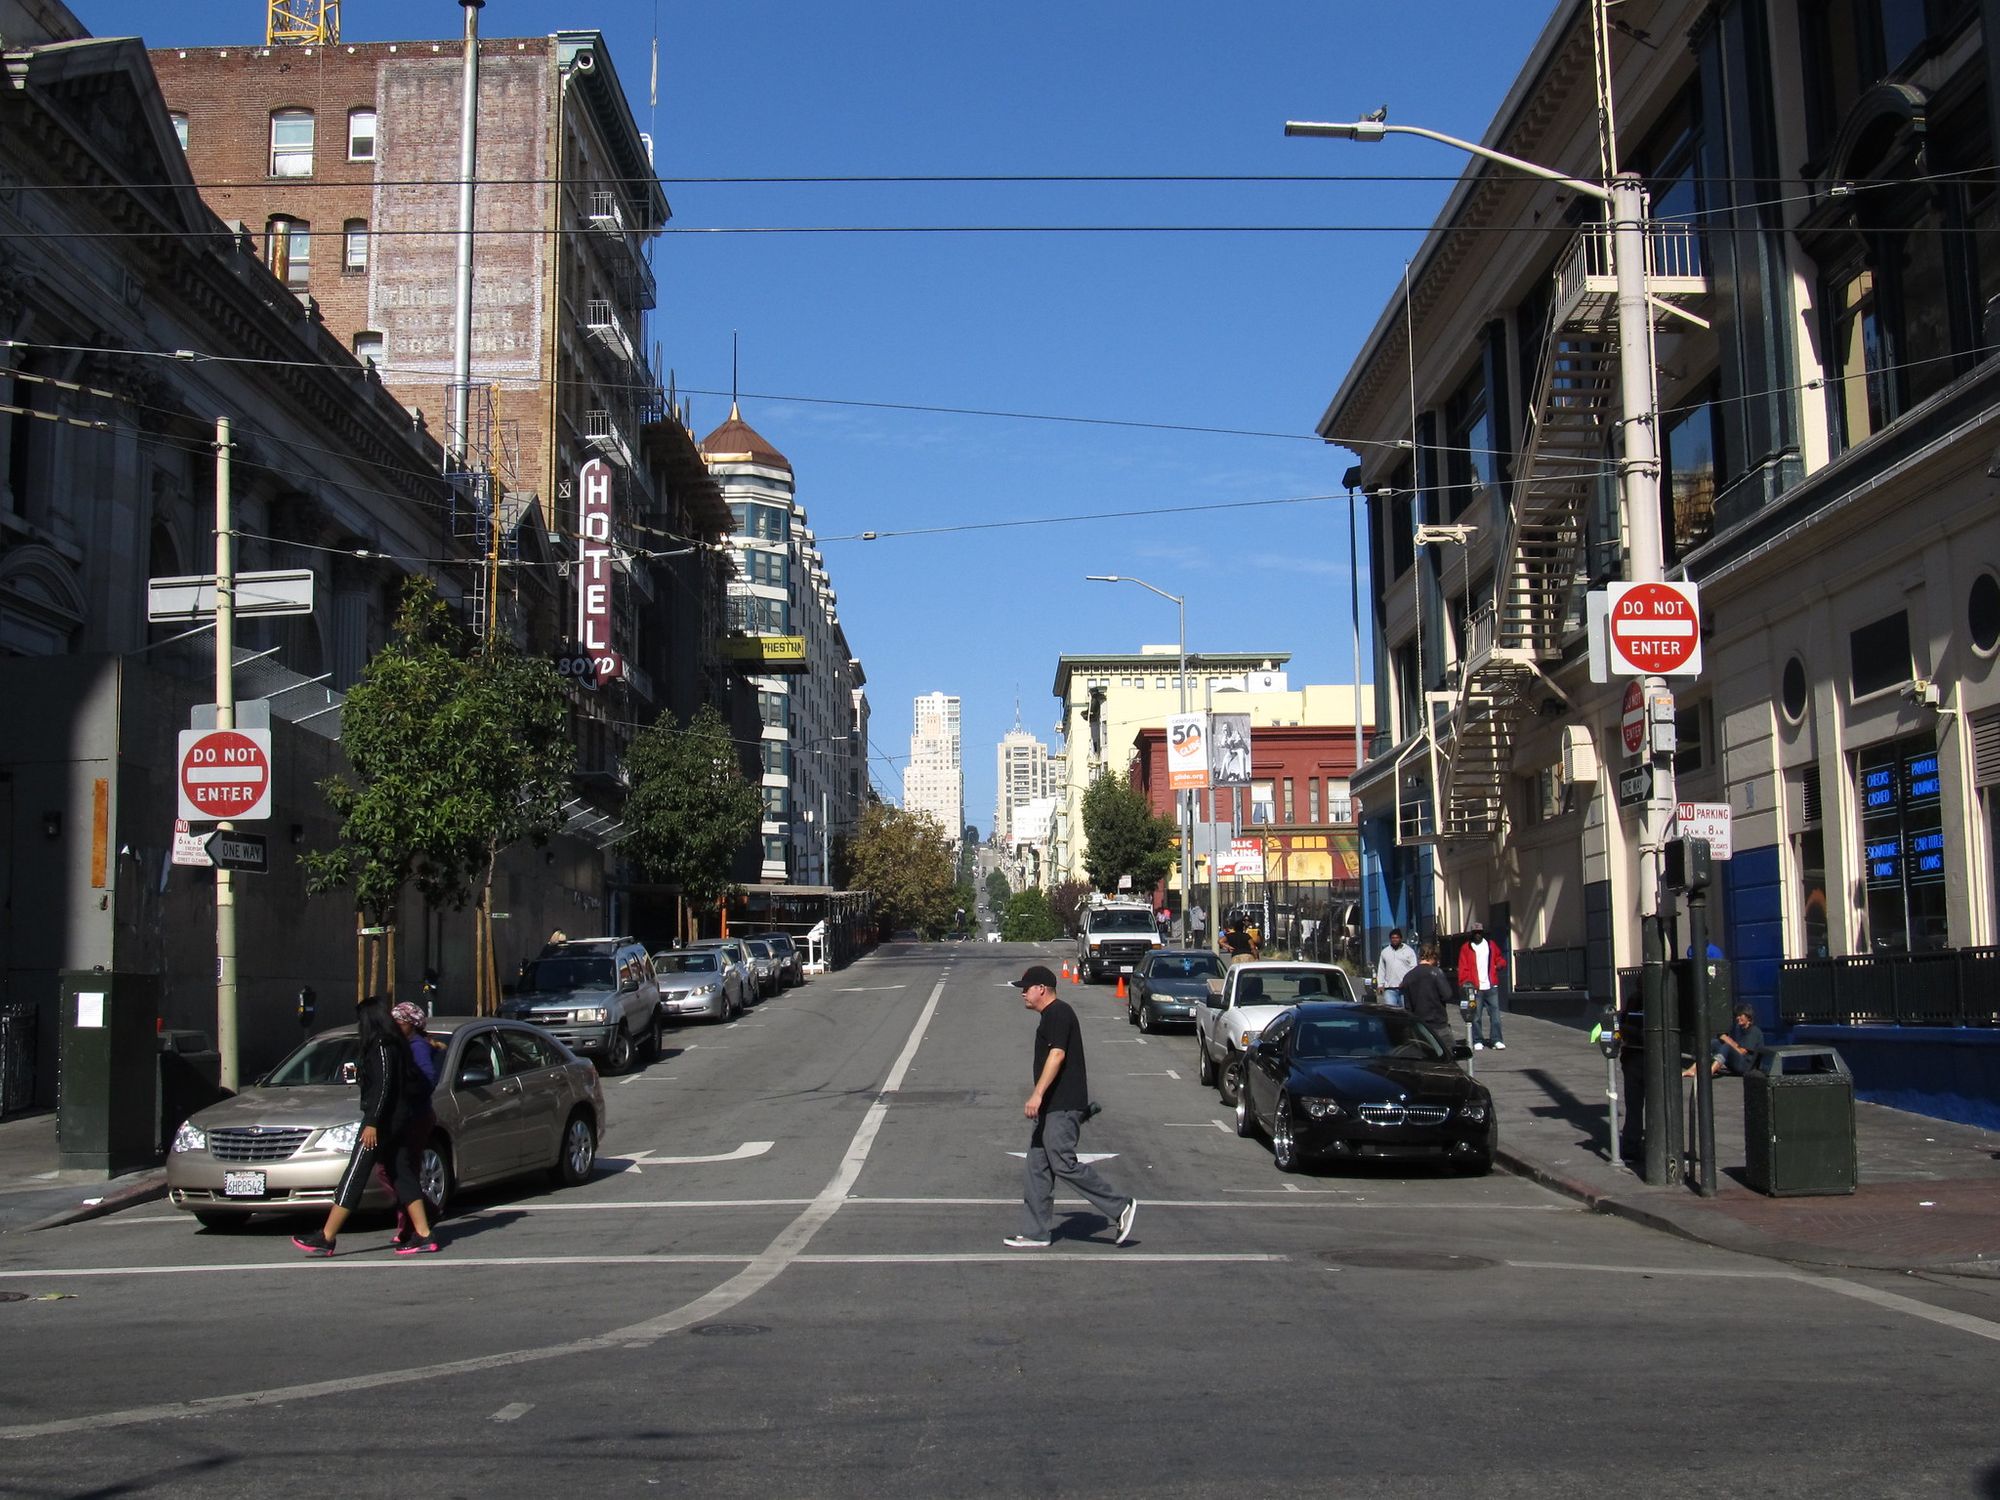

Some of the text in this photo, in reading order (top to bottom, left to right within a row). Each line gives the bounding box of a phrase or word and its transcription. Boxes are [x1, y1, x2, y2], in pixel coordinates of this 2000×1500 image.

[585, 475, 609, 650] HOTEL
[1623, 601, 1684, 615] DO NOT
[1631, 641, 1681, 655] ENTER
[558, 656, 614, 675] BOYD
[1172, 724, 1201, 745] 50
[1626, 724, 1642, 741] ENTER
[193, 748, 257, 762] DO NOT
[1867, 771, 1889, 788] CHECKS
[197, 787, 253, 802] ENTER
[1868, 789, 1890, 806] CASHED
[1680, 804, 1728, 819] NO PARKING
[177, 820, 188, 831] NO
[1683, 825, 1689, 834] 6
[1709, 825, 1714, 835] 8
[178, 836, 183, 845] 6
[197, 837, 202, 845] 8
[1231, 840, 1253, 848] BLIC
[223, 843, 260, 860] ONE WAY
[1227, 849, 1259, 857] KING
[228, 1180, 263, 1193] 6HPR542
